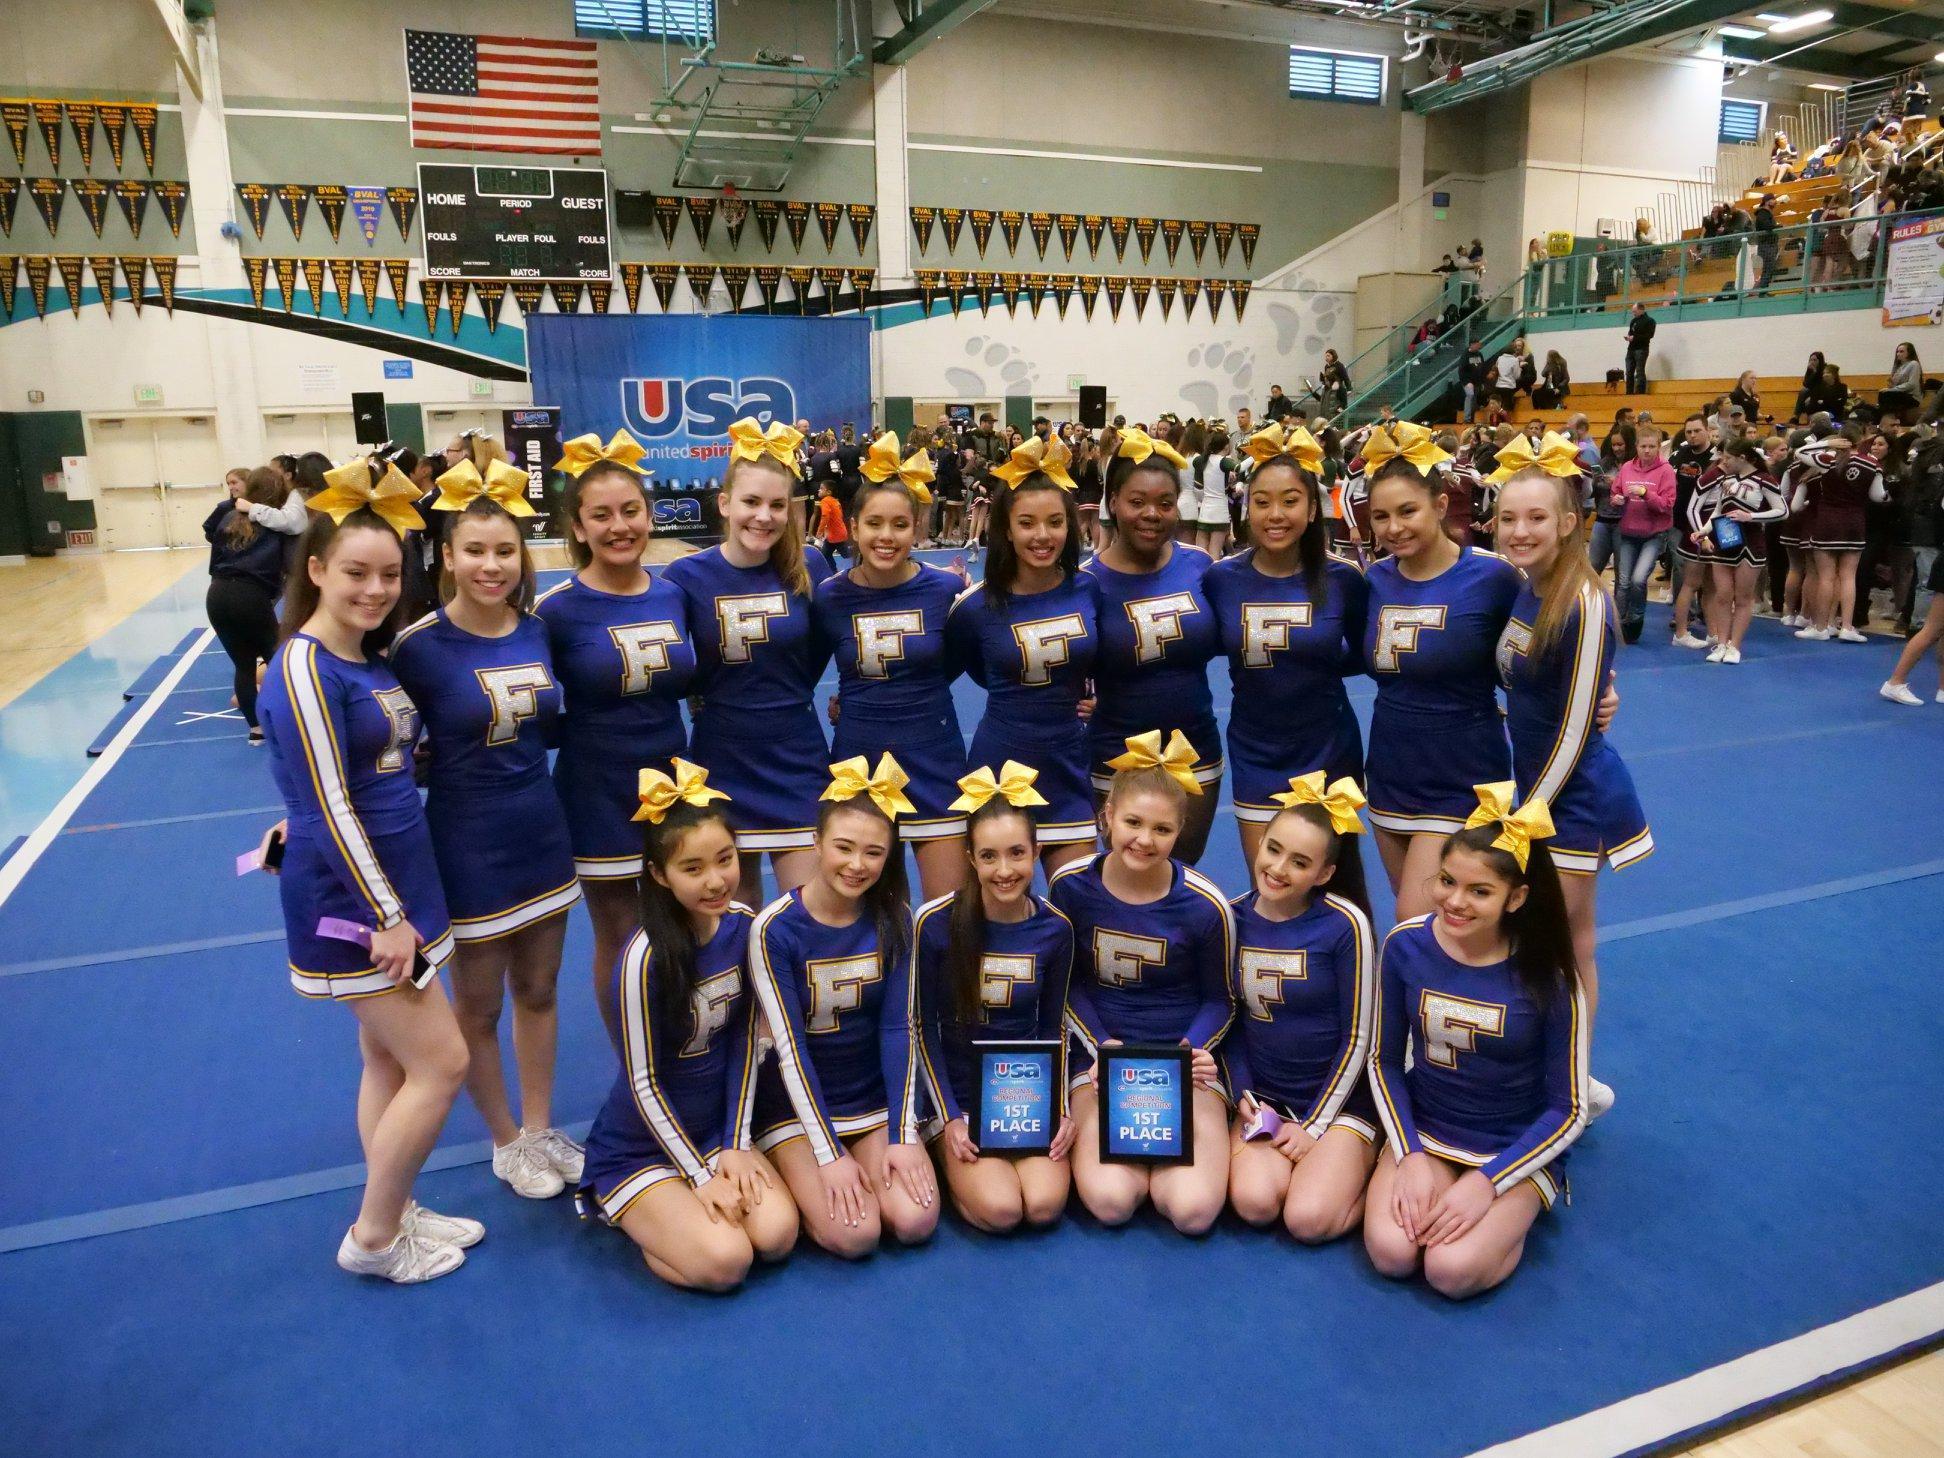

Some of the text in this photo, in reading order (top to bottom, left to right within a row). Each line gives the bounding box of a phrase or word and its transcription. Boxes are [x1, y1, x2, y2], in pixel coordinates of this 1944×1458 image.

[317, 186, 342, 194] BVAL
[427, 193, 466, 205] HOME
[500, 200, 532, 208] PERIOD
[561, 198, 603, 210] GUEST
[757, 201, 776, 209] BVAL
[1033, 212, 1049, 220] BVAL
[427, 233, 457, 241] FOULS
[495, 234, 557, 243] PLAYER FOUL
[1893, 224, 1922, 239] RULES
[578, 236, 605, 244] FOULS
[430, 268, 461, 276] SCORE
[510, 269, 540, 277] MATCH
[579, 269, 608, 278] SCORE
[526, 440, 544, 499] FIRST AID
[653, 498, 701, 524] sa
[75, 533, 93, 544] EXIT
[714, 591, 789, 664] F
[1123, 590, 1200, 666] F
[1241, 602, 1312, 669] F
[1373, 605, 1448, 673] F
[852, 609, 926, 680] F
[1010, 612, 1088, 686] F
[607, 620, 683, 696] F
[474, 662, 553, 746] F
[372, 686, 417, 773] F
[1093, 926, 1168, 987] F
[1239, 946, 1307, 1022] F
[805, 952, 884, 1033] F
[679, 965, 743, 1058] F
[1421, 988, 1507, 1069] F
[1004, 1105, 1030, 1118] 1ST
[1133, 1112, 1160, 1125] 1ST
[990, 1120, 1041, 1133] PLACE
[1120, 1127, 1172, 1141] PLACE
